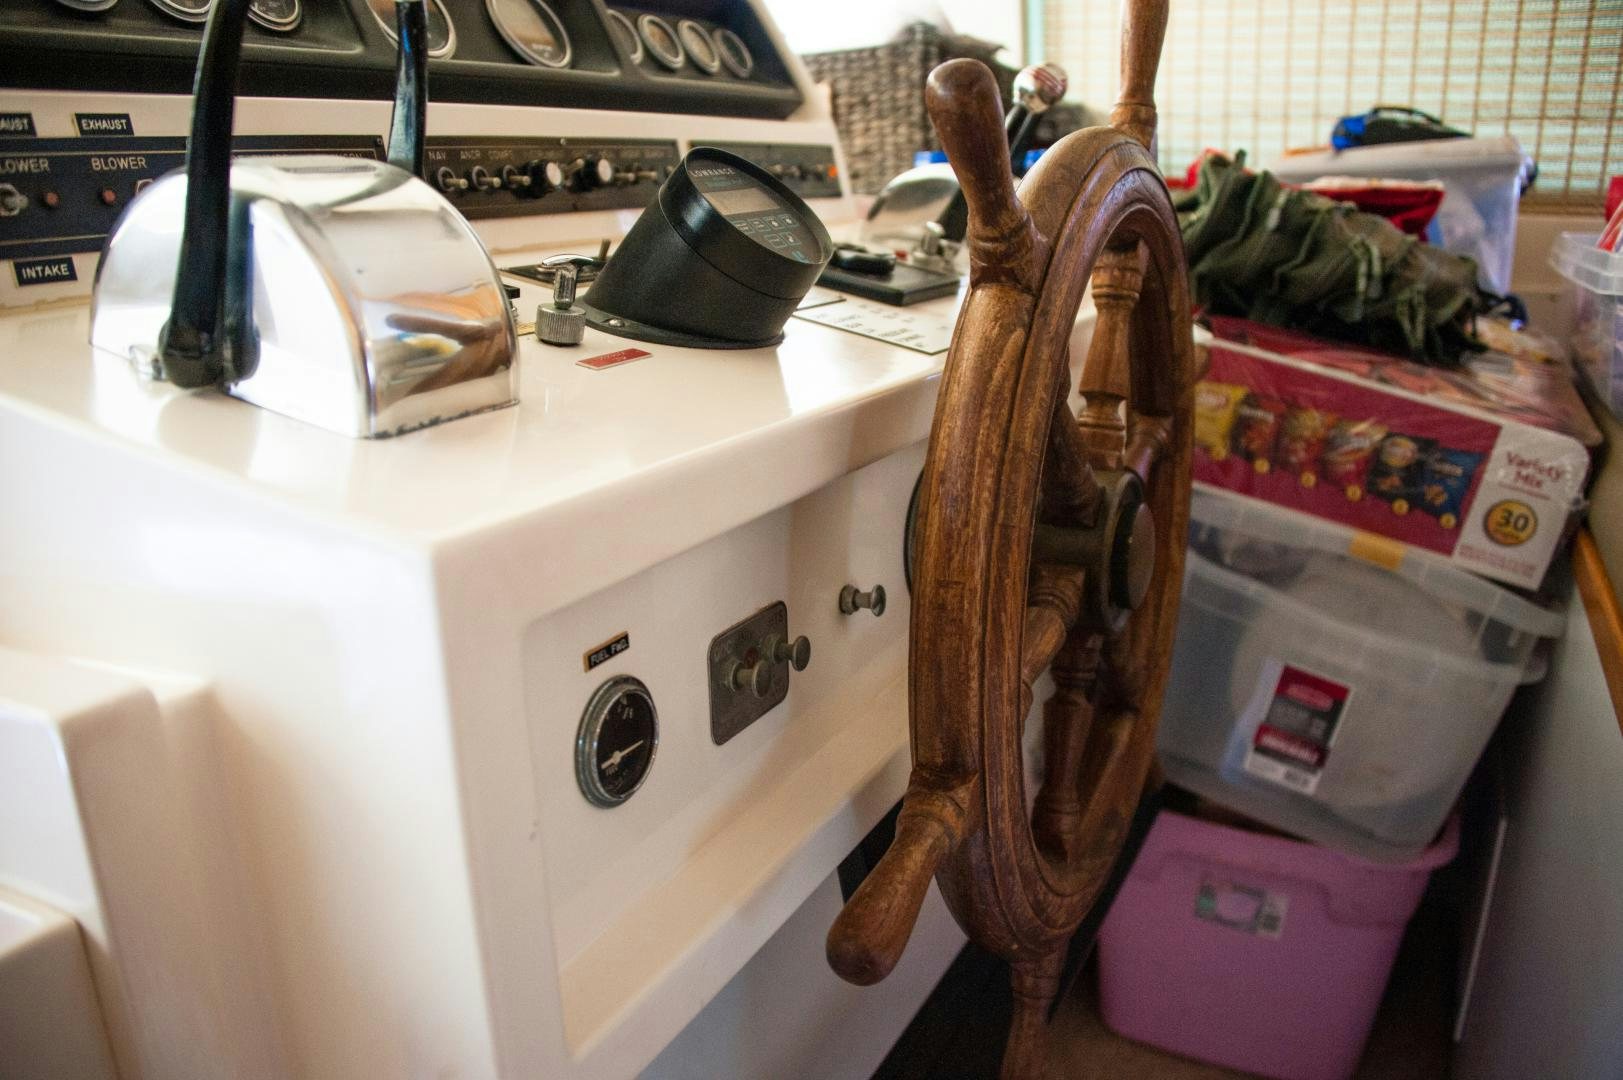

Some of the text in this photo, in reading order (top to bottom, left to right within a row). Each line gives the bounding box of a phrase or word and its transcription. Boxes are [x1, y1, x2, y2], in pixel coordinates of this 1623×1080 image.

[81, 119, 127, 130] EXHAUST
[428, 151, 446, 160] NAV
[91, 157, 147, 171] BLOWER
[21, 264, 69, 279] INTAKE
[1513, 469, 1544, 489] Mix
[1497, 509, 1530, 533] 30
[590, 650, 609, 666] FUEL
